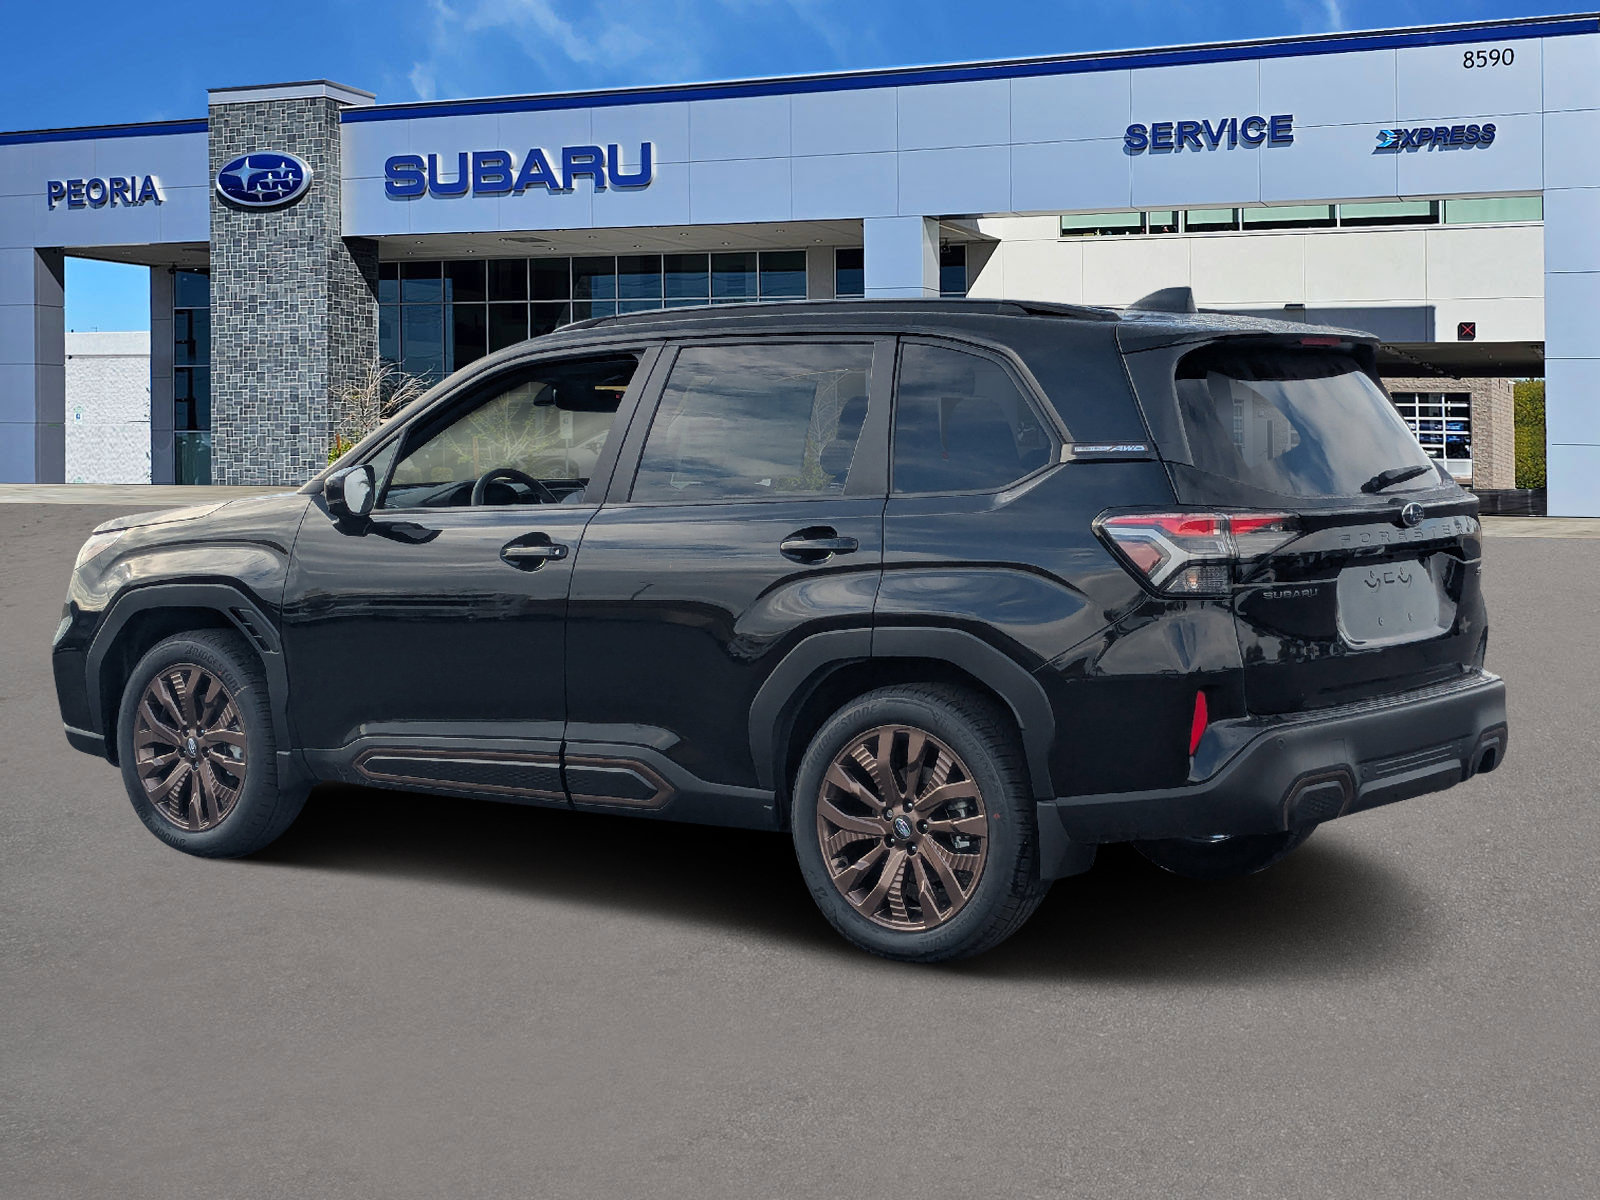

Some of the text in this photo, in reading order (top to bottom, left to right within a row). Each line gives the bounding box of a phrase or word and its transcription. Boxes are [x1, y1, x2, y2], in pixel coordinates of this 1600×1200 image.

[1463, 48, 1515, 69] 8590
[1126, 114, 1294, 151] SERVICE
[1375, 123, 1496, 150] EXPRESS
[385, 142, 653, 197] SUBARU
[47, 174, 162, 208] PEORIA
[1262, 588, 1318, 600] SUBARU
